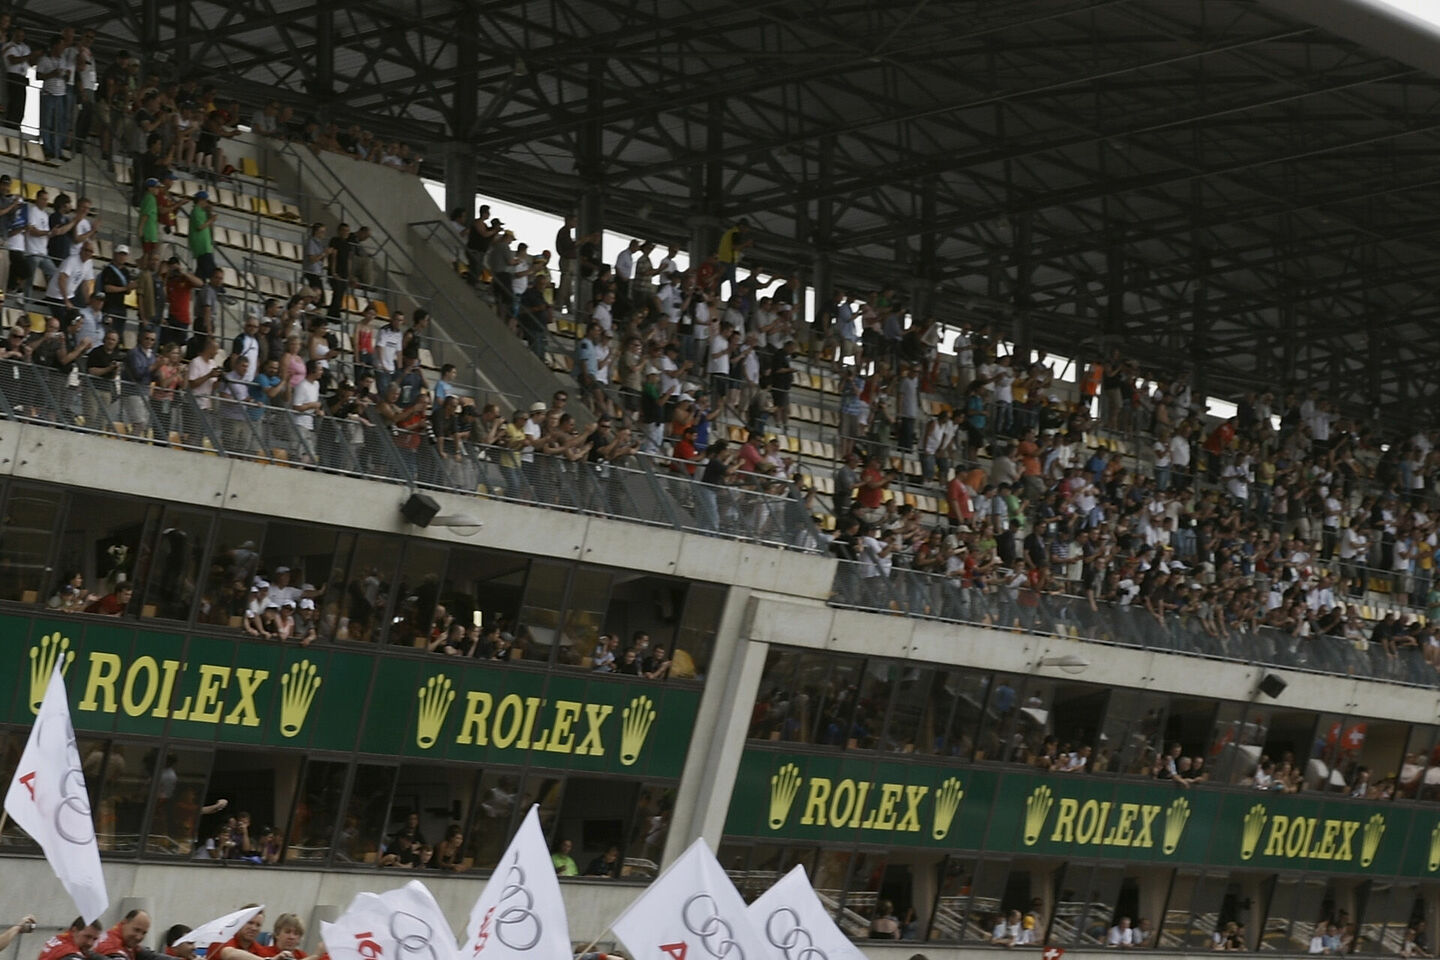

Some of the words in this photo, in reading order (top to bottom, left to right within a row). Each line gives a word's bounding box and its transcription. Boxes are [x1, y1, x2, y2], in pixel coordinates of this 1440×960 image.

[79, 652, 268, 726] ROLEX
[457, 691, 613, 755] ROLEX
[801, 778, 927, 831] ROLEX
[1051, 798, 1161, 848] ROLEX
[1265, 816, 1360, 860] ROLEX
